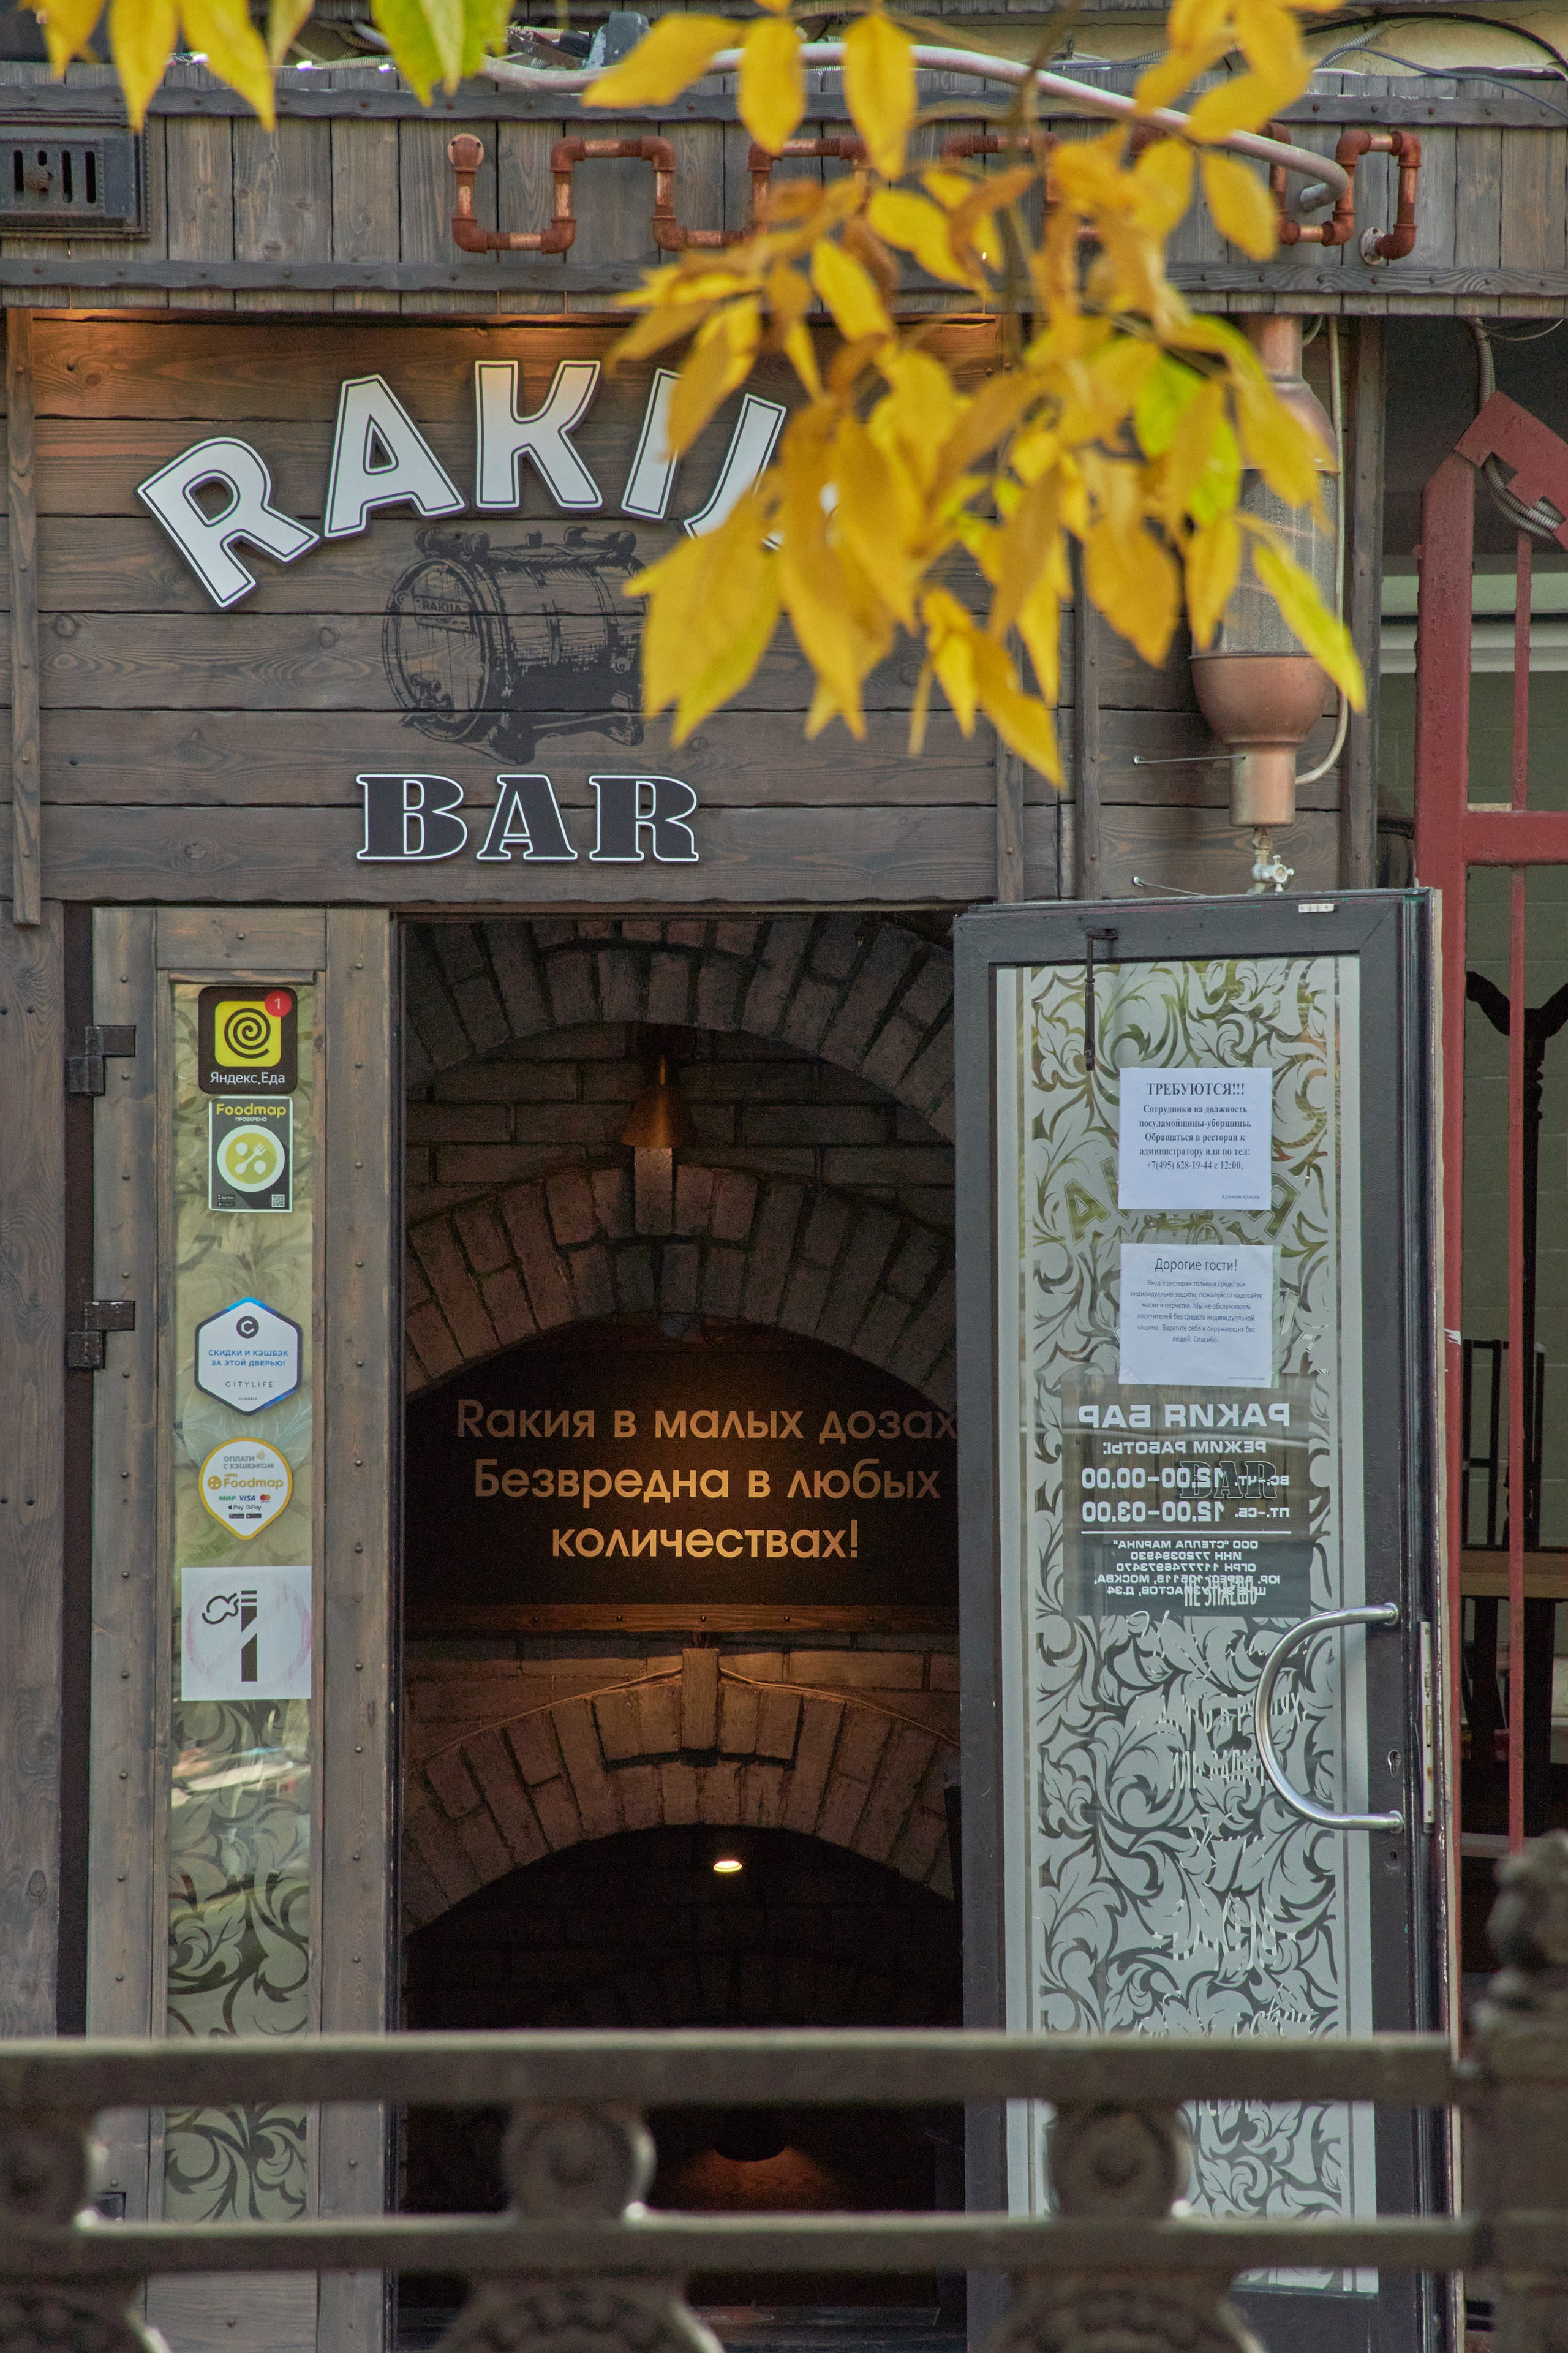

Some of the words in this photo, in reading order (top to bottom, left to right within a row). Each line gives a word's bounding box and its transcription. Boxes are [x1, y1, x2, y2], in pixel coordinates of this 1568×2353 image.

[137, 361, 843, 607] RAKIJ
[356, 774, 699, 861] BAR
[274, 997, 281, 1010] 1
[209, 1071, 285, 1085] Яндекс.Еда
[1147, 1082, 1245, 1095] ТРЕБУЮТСЯ!!!
[216, 1103, 287, 1119] Foodmap
[1144, 1105, 1191, 1115] Сотрудники
[1145, 1132, 1193, 1143] Обращаться
[1202, 1135, 1238, 1144] ресторан
[1139, 1149, 1203, 1157] администратору
[1146, 1160, 1175, 1171] +7(495)
[1176, 1160, 1212, 1169] 628-19-44
[1220, 1160, 1243, 1169] 12:00.
[1155, 1258, 1202, 1272] Дорогие
[1205, 1259, 1237, 1271] гости!
[1212, 1302, 1251, 1311] обслуживаем
[614, 1410, 636, 1438] в
[655, 1410, 804, 1438] малых
[818, 1410, 958, 1445] дозах
[223, 1477, 284, 1489] Foodmap
[475, 1459, 729, 1509] Безвредна
[748, 1470, 771, 1498] в
[787, 1459, 941, 1499] любых
[552, 1520, 858, 1558] количествах!
